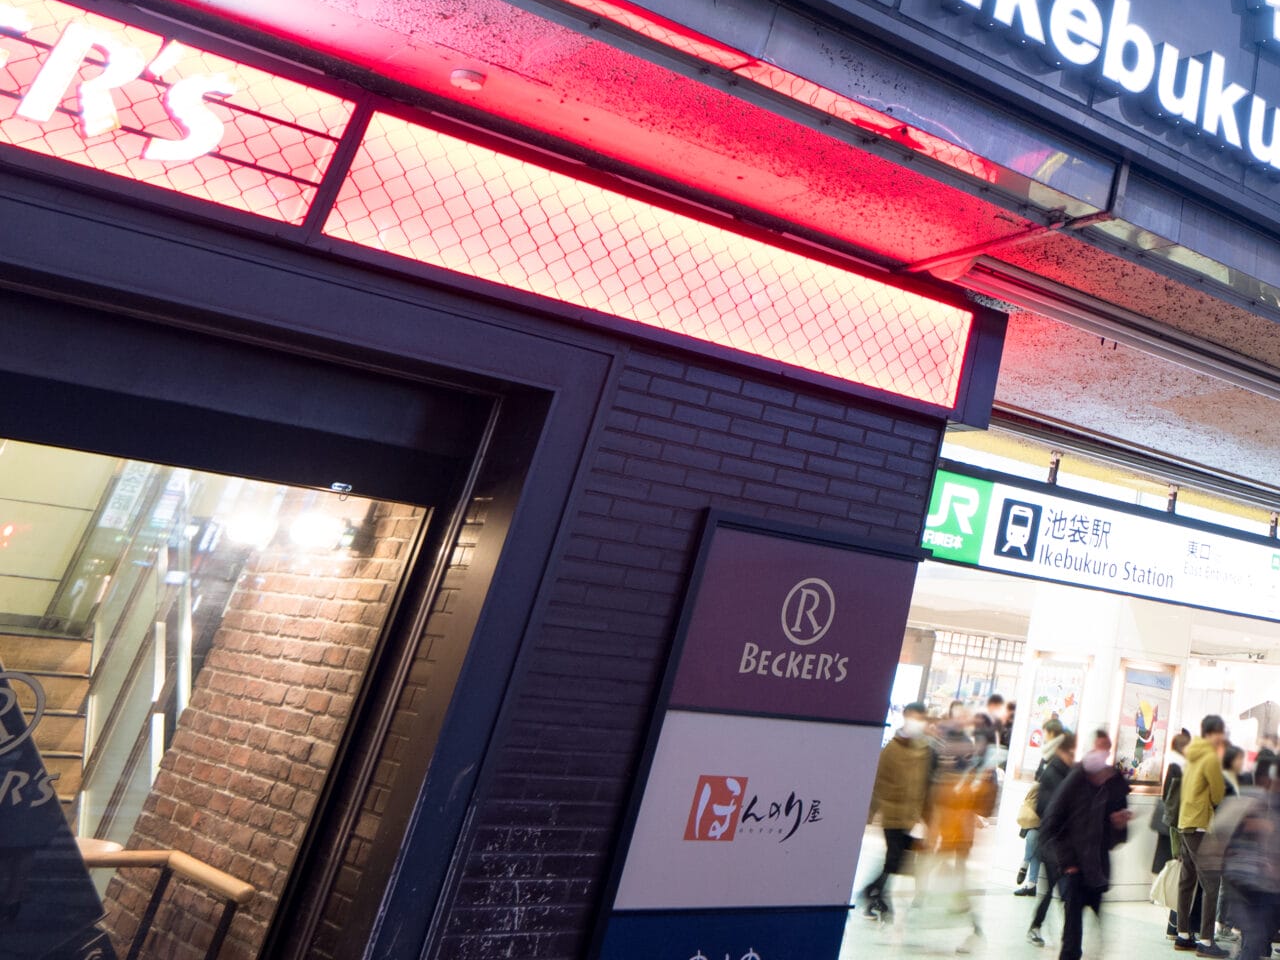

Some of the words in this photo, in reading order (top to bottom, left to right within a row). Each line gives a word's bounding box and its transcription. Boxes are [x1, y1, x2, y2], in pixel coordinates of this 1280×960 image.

[926, 481, 980, 535] JR
[1044, 508, 1112, 550] 池袋駅
[1038, 543, 1118, 578] Ikebukuro
[1122, 561, 1174, 589] Station
[1187, 540, 1211, 561] 東口
